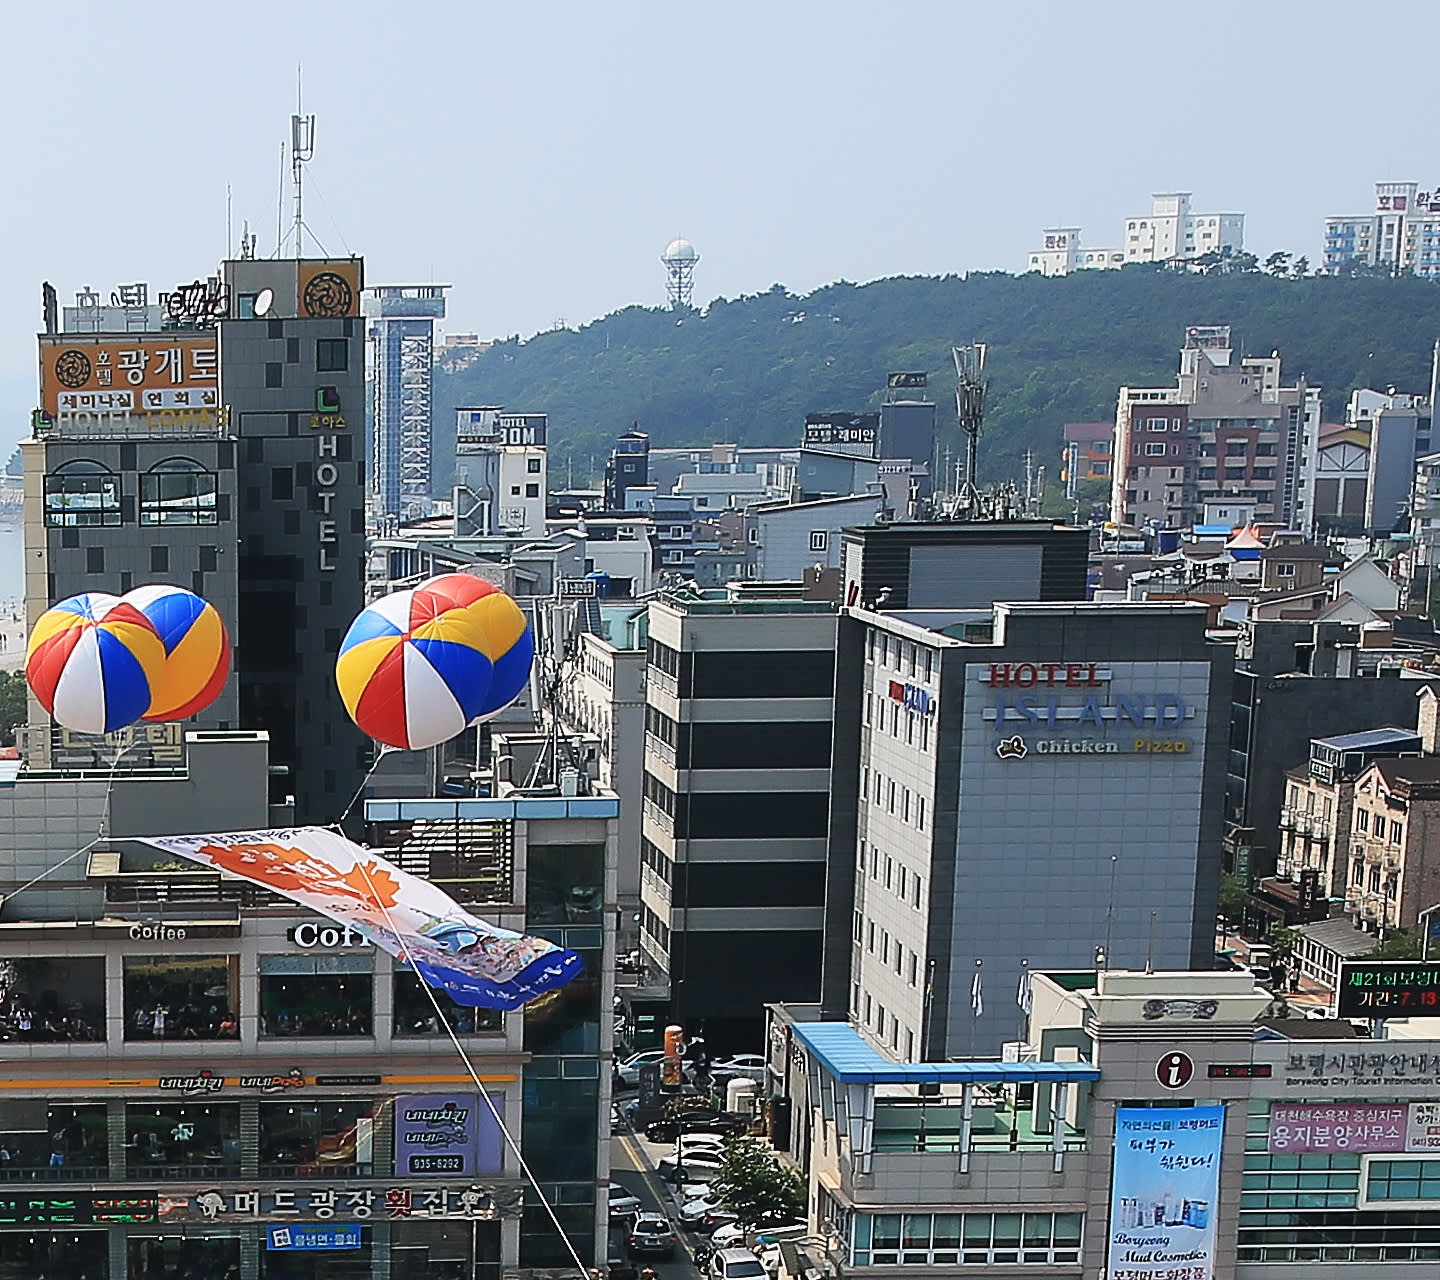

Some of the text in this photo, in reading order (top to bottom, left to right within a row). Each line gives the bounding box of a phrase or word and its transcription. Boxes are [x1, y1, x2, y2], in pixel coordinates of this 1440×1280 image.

[317, 435, 338, 571] HOTEL
[989, 663, 1103, 688] HOTEL
[995, 692, 1187, 732] ISLAND
[1036, 738, 1186, 754] Chicken Pizza
[129, 925, 186, 941] Coffee
[1120, 1248, 1207, 1263] Mud Cosmetics
